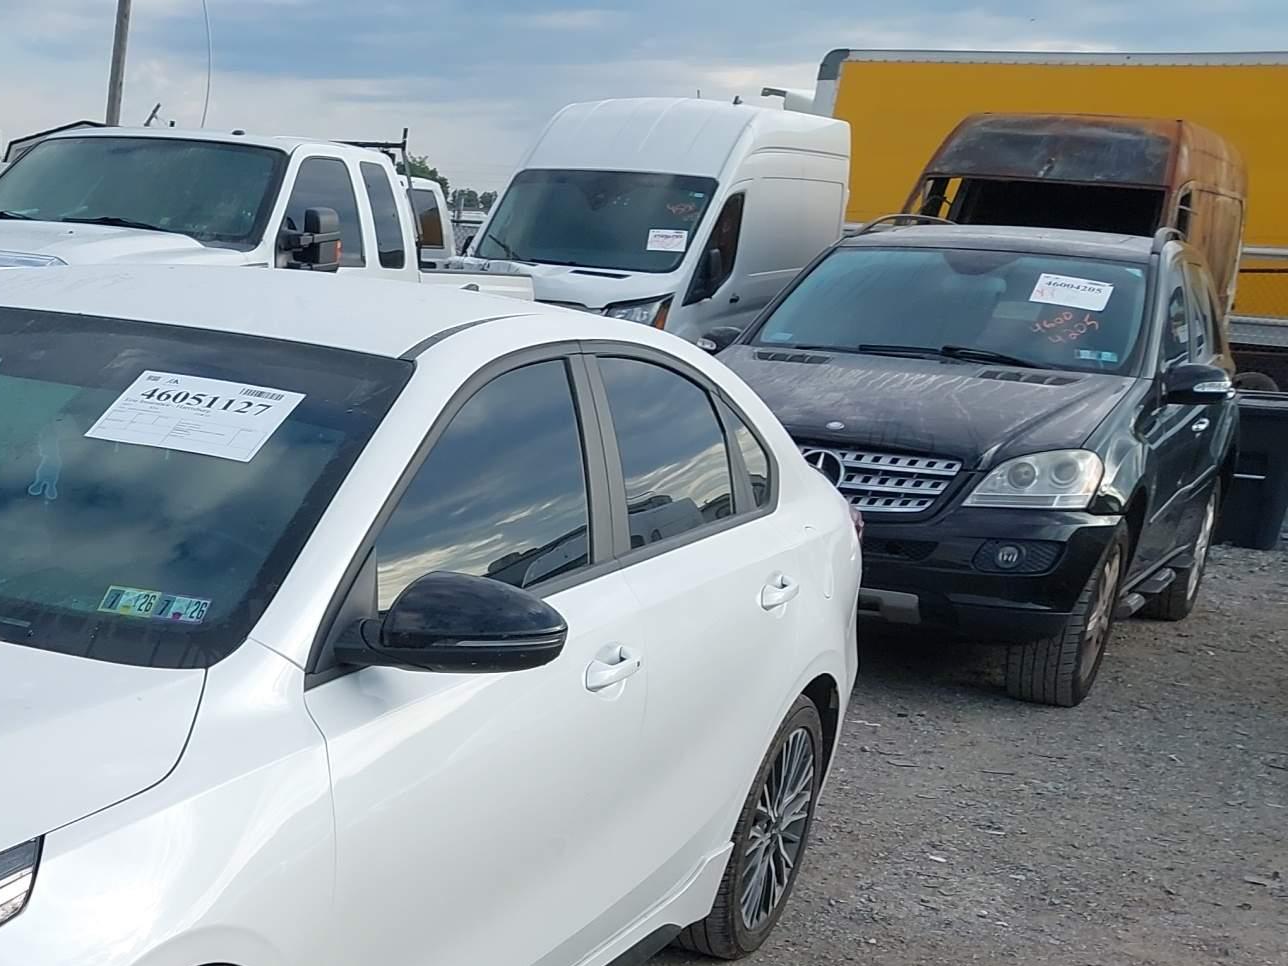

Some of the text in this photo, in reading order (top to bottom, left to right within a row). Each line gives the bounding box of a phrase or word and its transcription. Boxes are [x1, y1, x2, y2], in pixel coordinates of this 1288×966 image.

[1045, 280, 1104, 295] 46004205
[140, 387, 273, 416] 46051127
[136, 594, 156, 613] 26
[188, 600, 208, 620] 26
